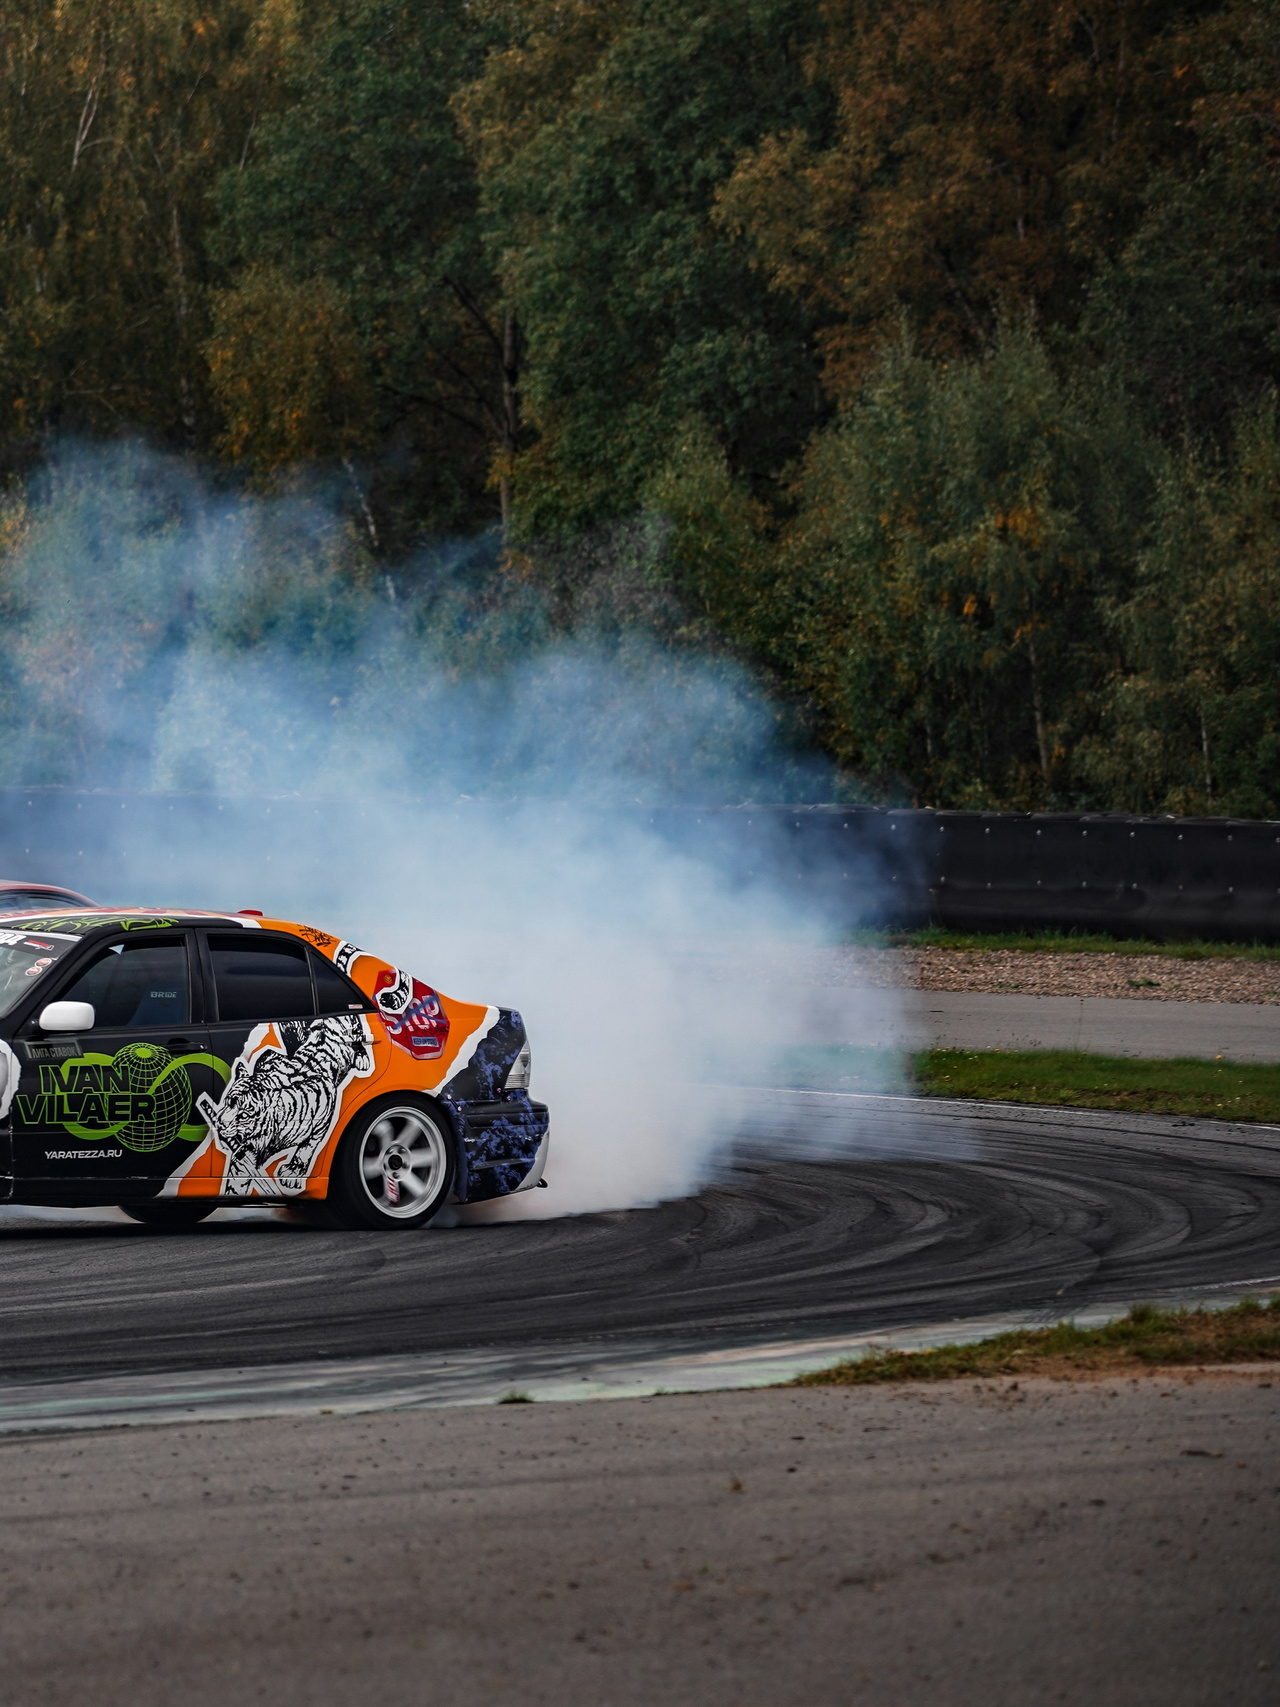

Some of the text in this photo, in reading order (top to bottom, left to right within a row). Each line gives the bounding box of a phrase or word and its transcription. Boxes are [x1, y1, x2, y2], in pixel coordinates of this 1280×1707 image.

[32, 1046, 77, 1058] ЛИГА СТАВОК
[39, 1065, 131, 1094] IVAN
[16, 1093, 156, 1124] VILAER
[45, 1150, 122, 1159] YARATEZZA.RU
